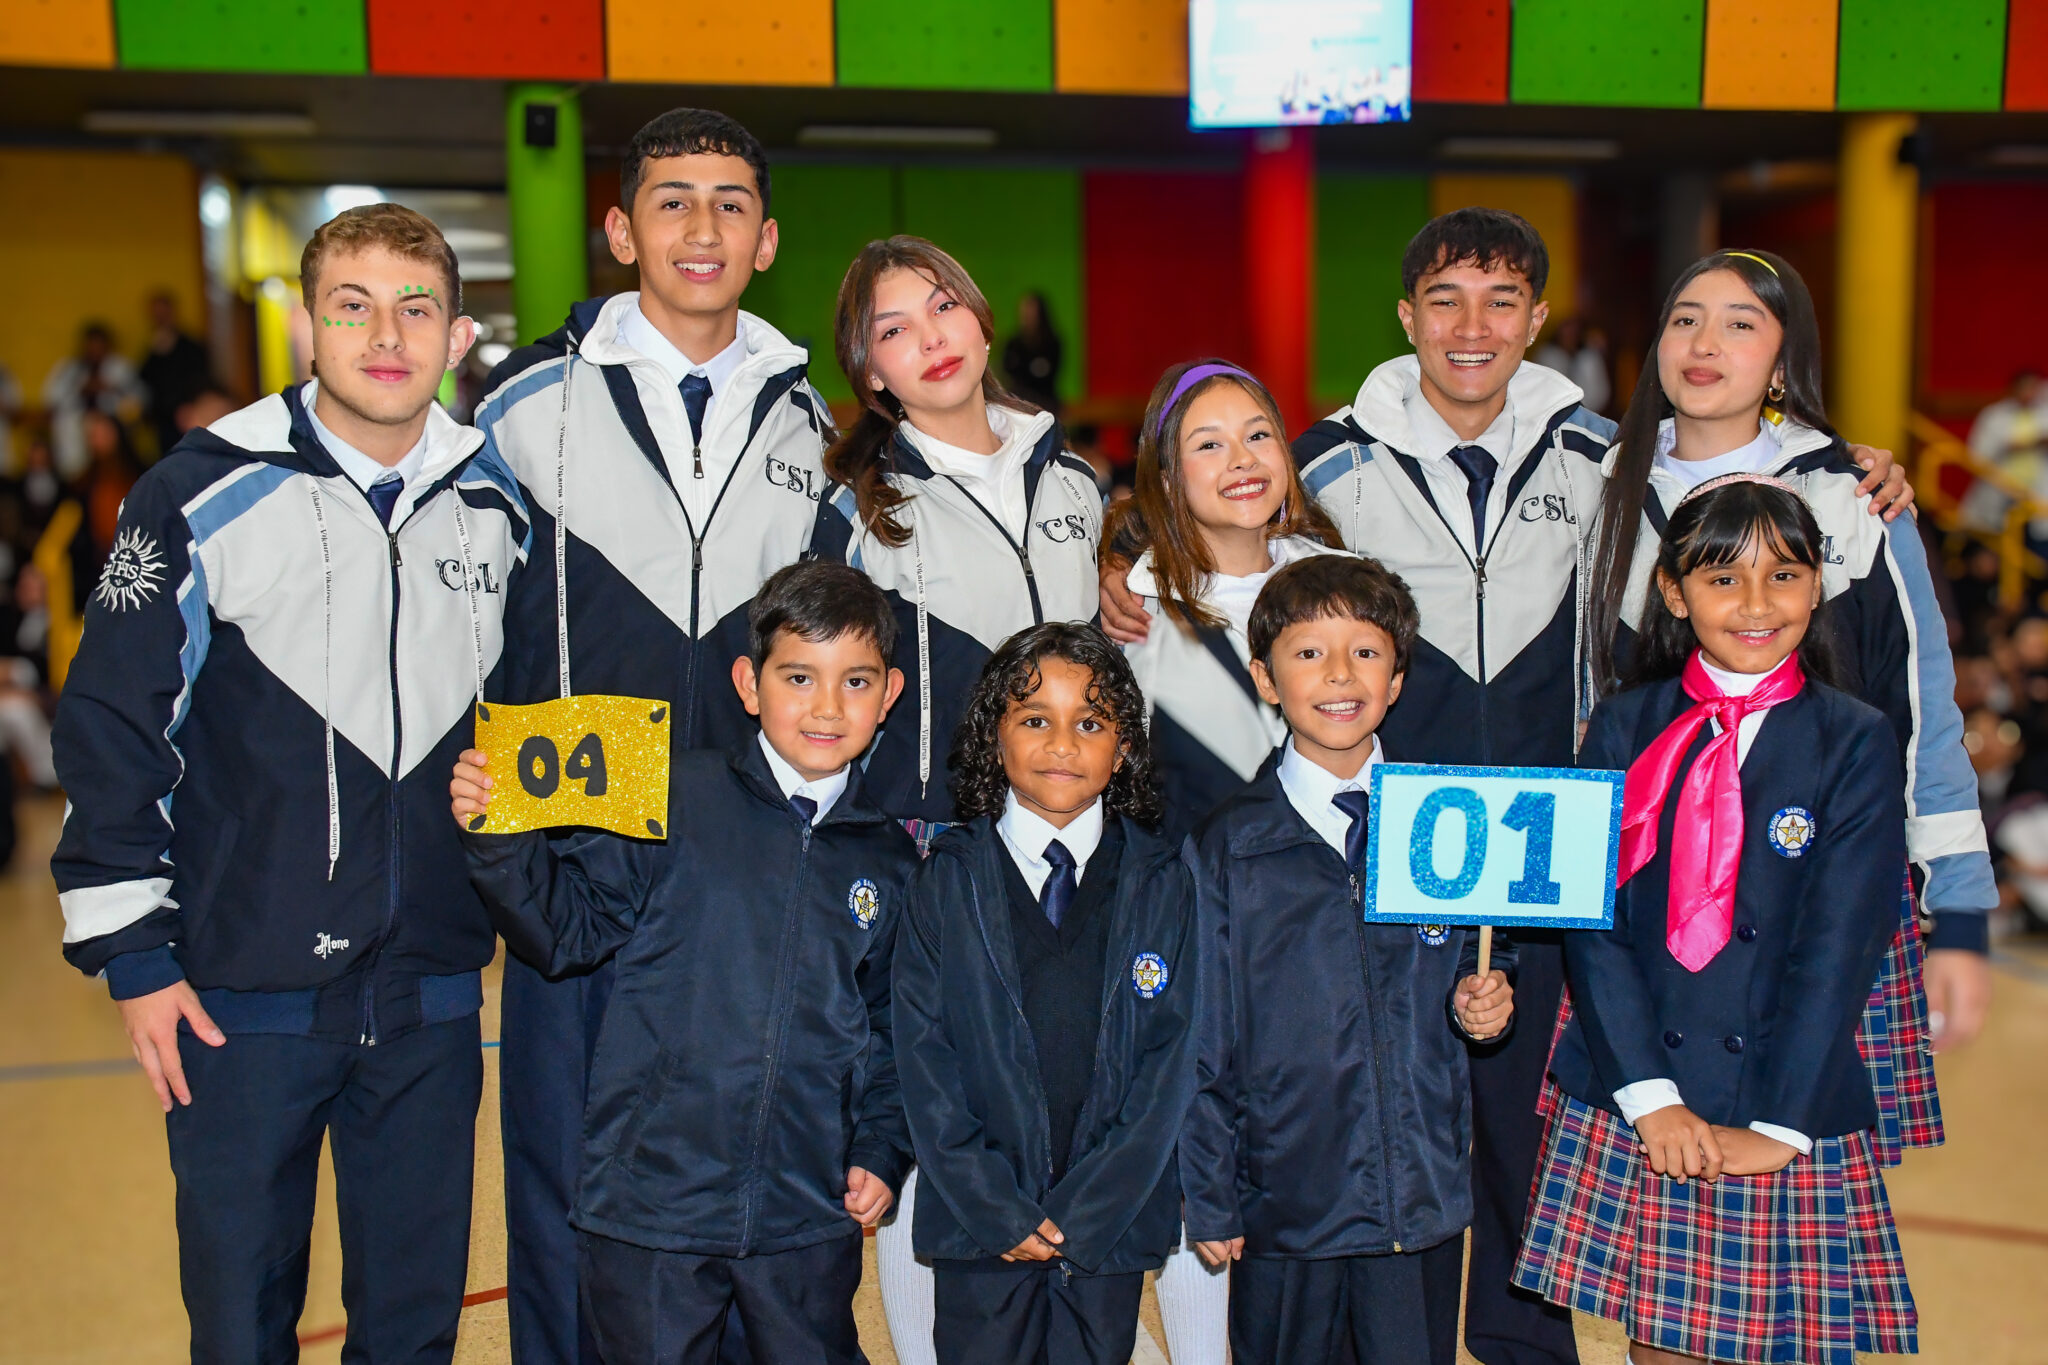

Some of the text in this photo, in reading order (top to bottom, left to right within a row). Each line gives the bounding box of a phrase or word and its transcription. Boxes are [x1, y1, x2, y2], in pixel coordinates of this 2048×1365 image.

[558, 425, 566, 458] Vikairus
[1352, 446, 1361, 472] Vikairus
[1557, 452, 1569, 480] Vikairus
[766, 453, 820, 502] CSL
[1062, 475, 1082, 501] Vikairus
[1519, 494, 1577, 525] CSL
[308, 489, 323, 522] Vikairus
[319, 528, 331, 563] Vikairus
[1036, 515, 1095, 556] CS
[1588, 533, 1596, 562] Vikairus
[110, 561, 140, 580] IHS
[916, 562, 925, 595] Vikairus
[454, 503, 466, 537] Vikairus
[462, 542, 474, 575] Vikairus
[469, 581, 478, 614] Vikairus
[477, 659, 485, 692] Vikairus
[920, 640, 928, 672] Vikairus
[921, 729, 929, 761] Vikairus
[517, 733, 608, 799] 04
[330, 822, 338, 856] Vikairus
[1769, 814, 1782, 843] COLEGIO
[1784, 807, 1806, 817] SANTA
[1409, 787, 1561, 905] 01
[848, 880, 861, 910] COLEGIO
[313, 932, 350, 960] Mono
[1142, 953, 1160, 963] SANTA
